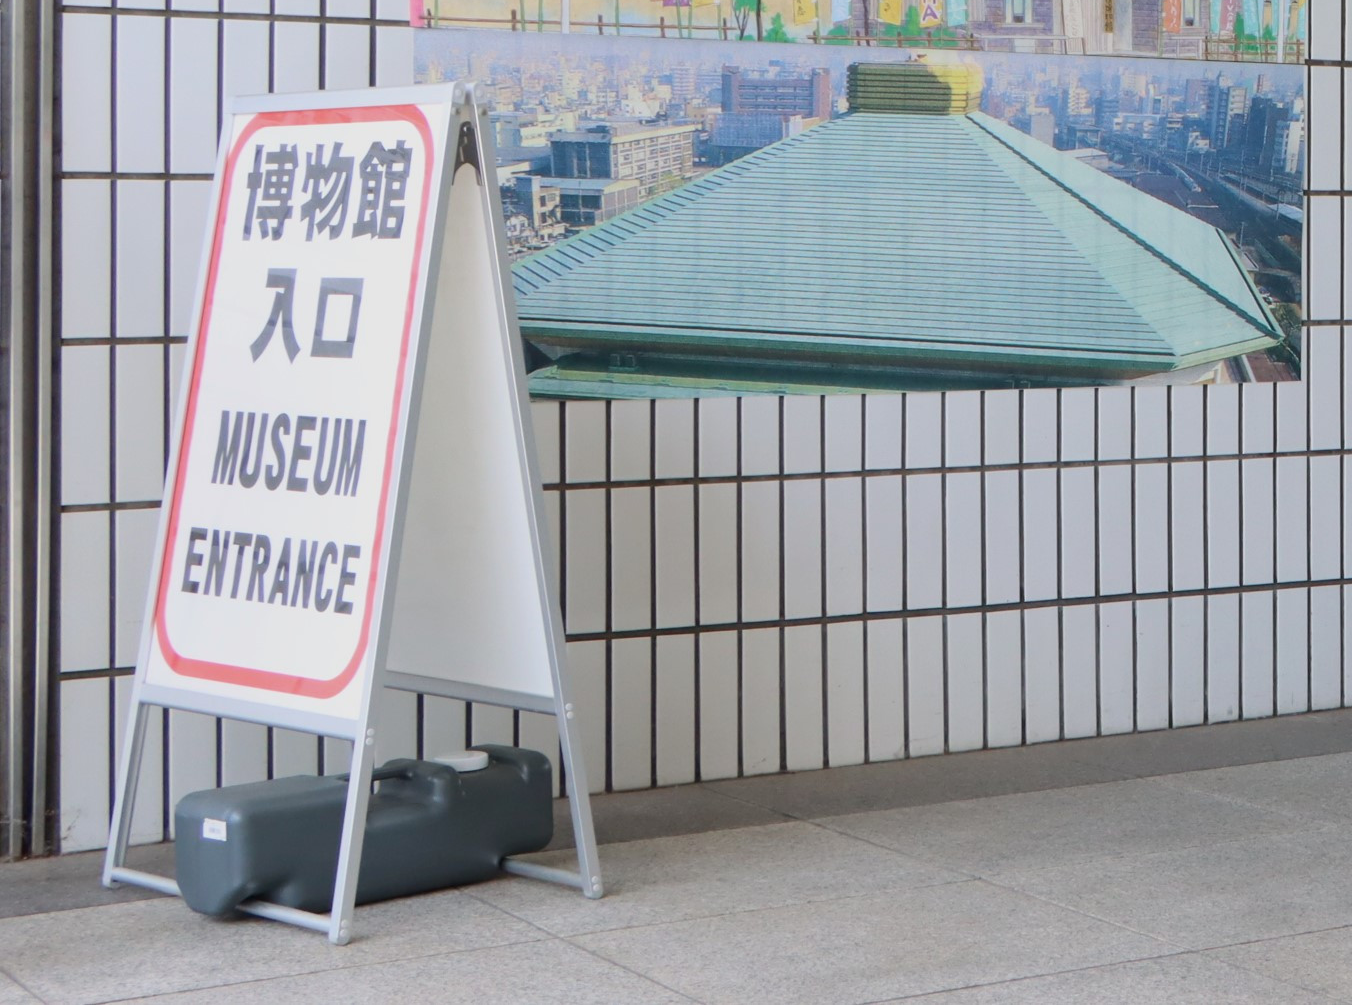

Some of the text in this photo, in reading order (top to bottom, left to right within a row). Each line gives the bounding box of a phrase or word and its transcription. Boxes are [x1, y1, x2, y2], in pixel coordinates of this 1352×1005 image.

[242, 139, 412, 242] 博物館
[249, 267, 364, 363] 入口
[211, 409, 367, 498] MUSEUM
[181, 526, 361, 615] ENTRANCE
